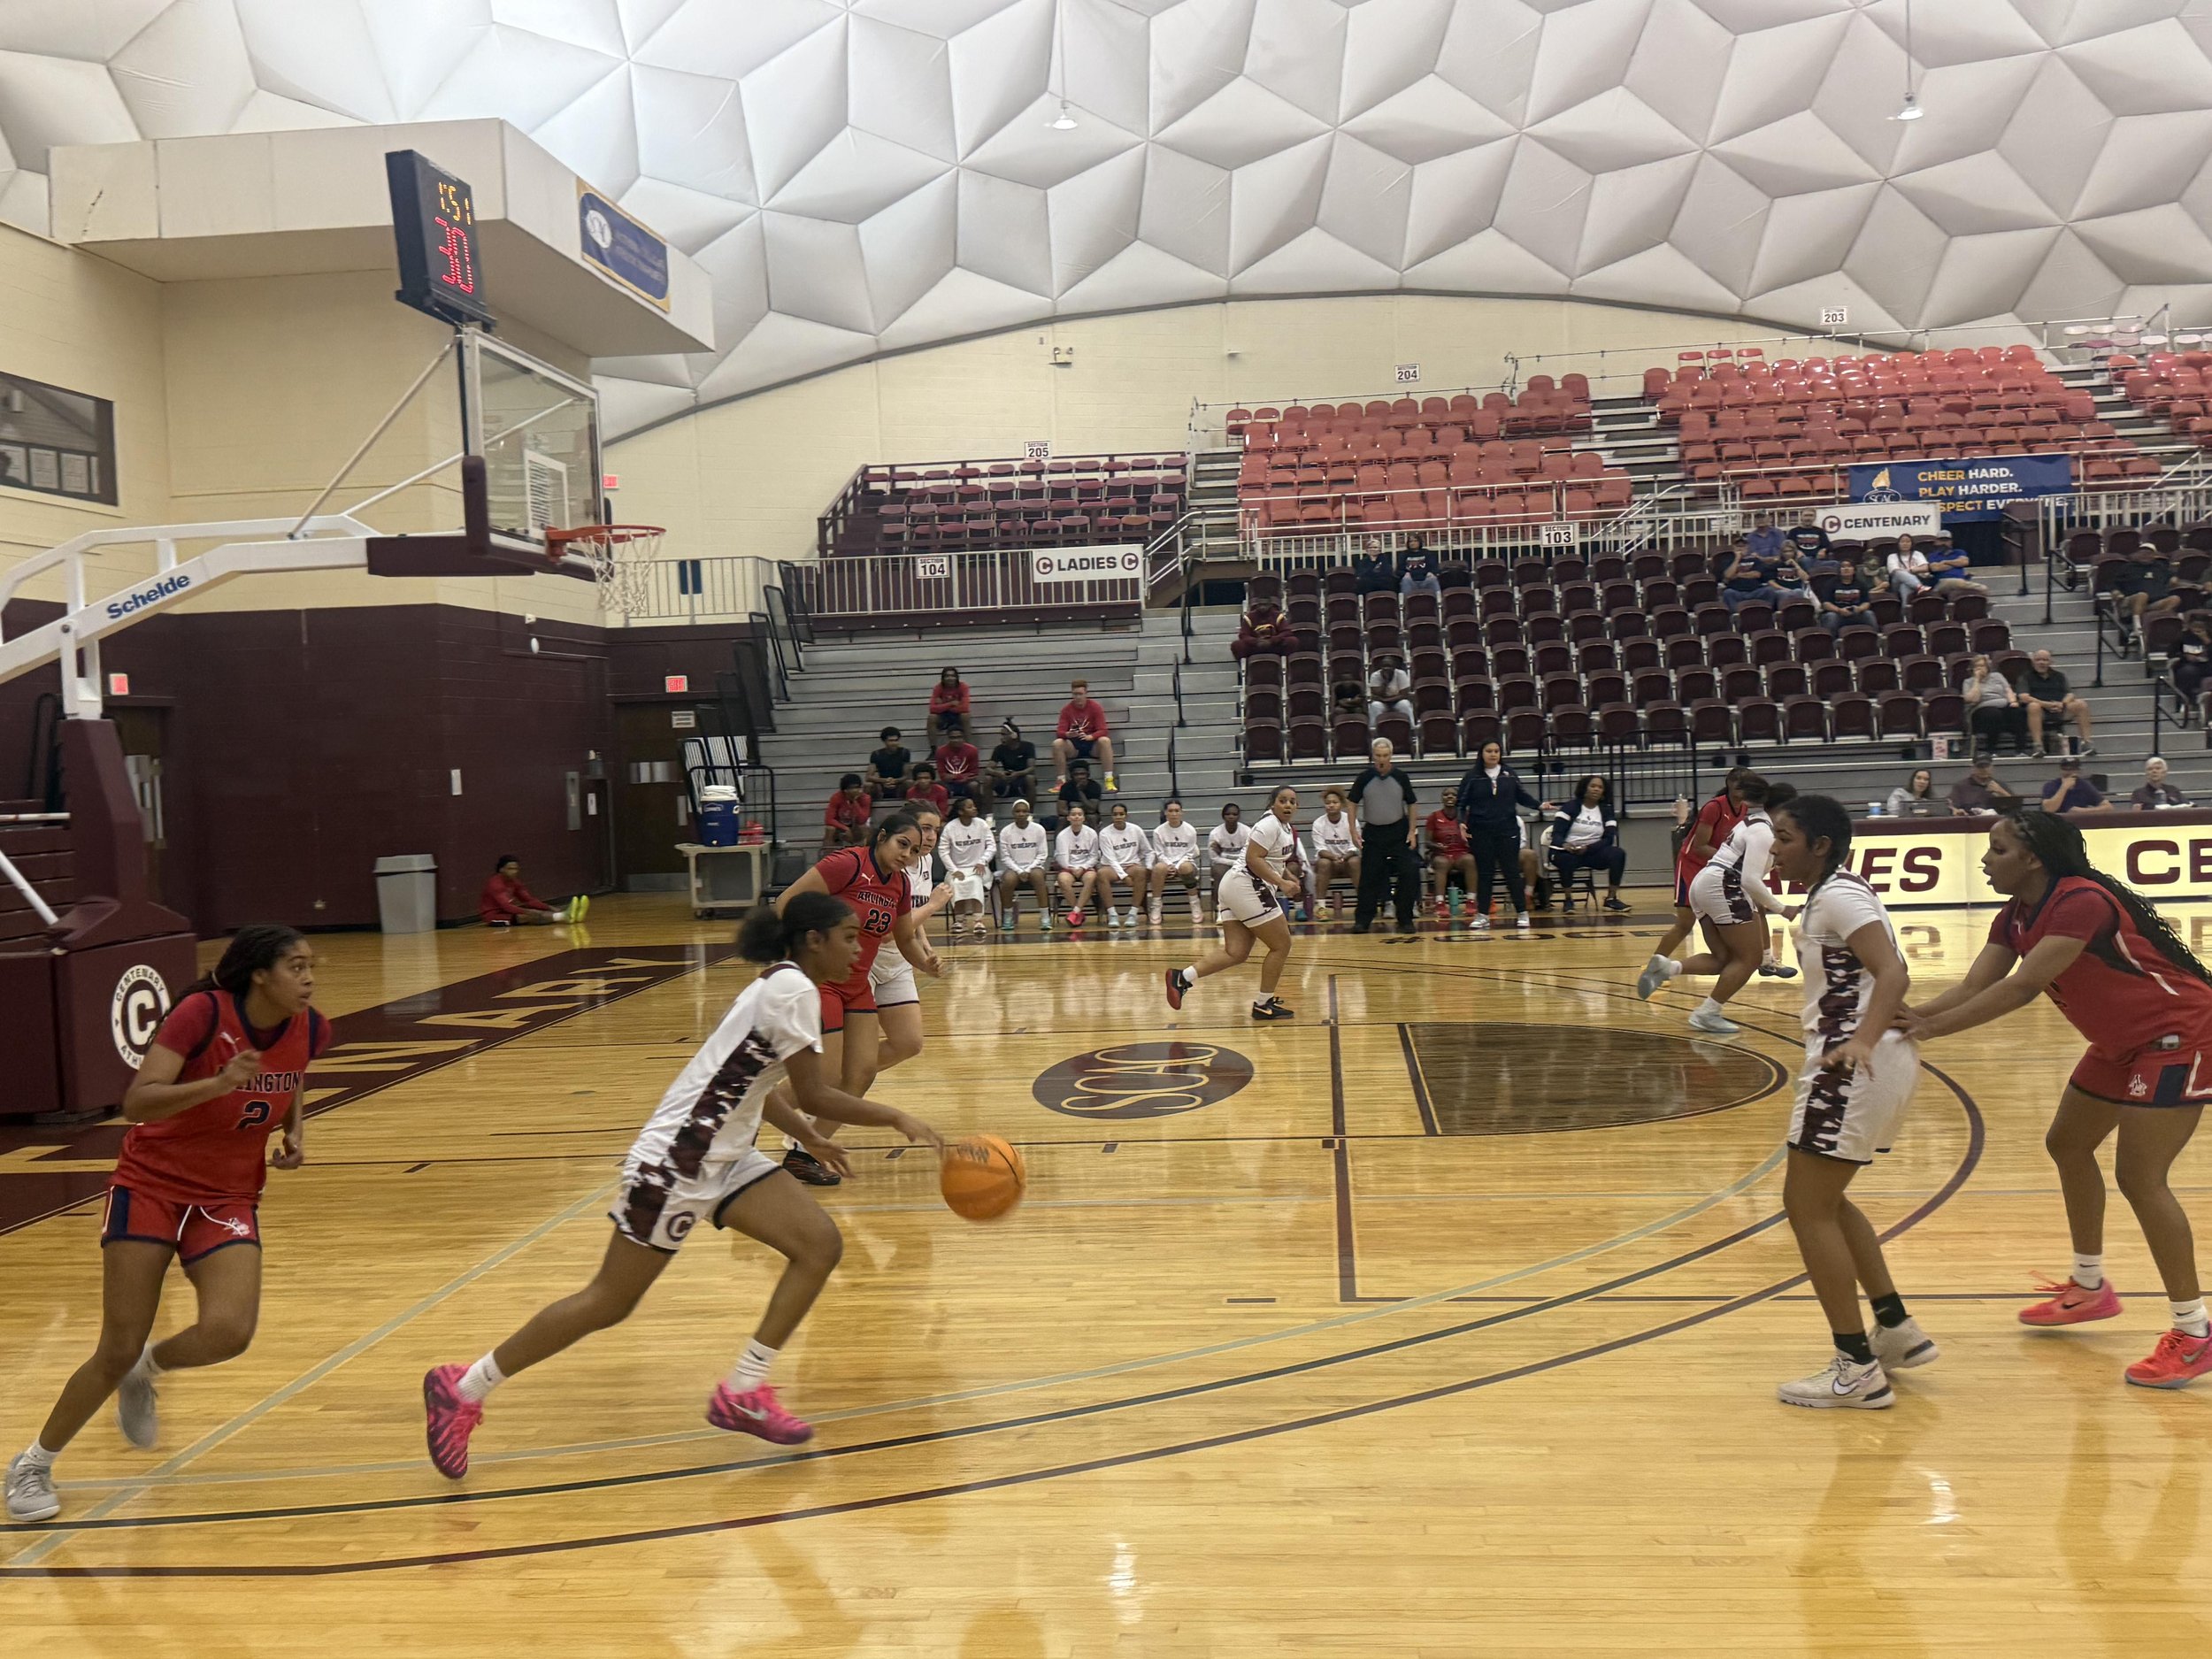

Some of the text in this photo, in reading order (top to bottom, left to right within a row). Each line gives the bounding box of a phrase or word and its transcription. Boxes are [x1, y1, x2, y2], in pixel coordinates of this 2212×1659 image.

[1824, 313, 1844, 322] 203
[1398, 370, 1417, 380] 204
[1029, 448, 1048, 457] 205
[1917, 467, 2014, 481] CHEER HARD.
[1918, 482, 2023, 497] PLAY HARDER.
[1939, 500, 1983, 513] SPECT
[1844, 515, 1931, 528] CENTENARY
[1546, 532, 1571, 543] 103
[921, 564, 945, 575] 104
[1057, 557, 1117, 572] LADIES
[107, 576, 189, 619] Schelde
[864, 908, 892, 934] 23
[116, 968, 165, 1002] CENTENARY
[235, 1100, 271, 1131] 2
